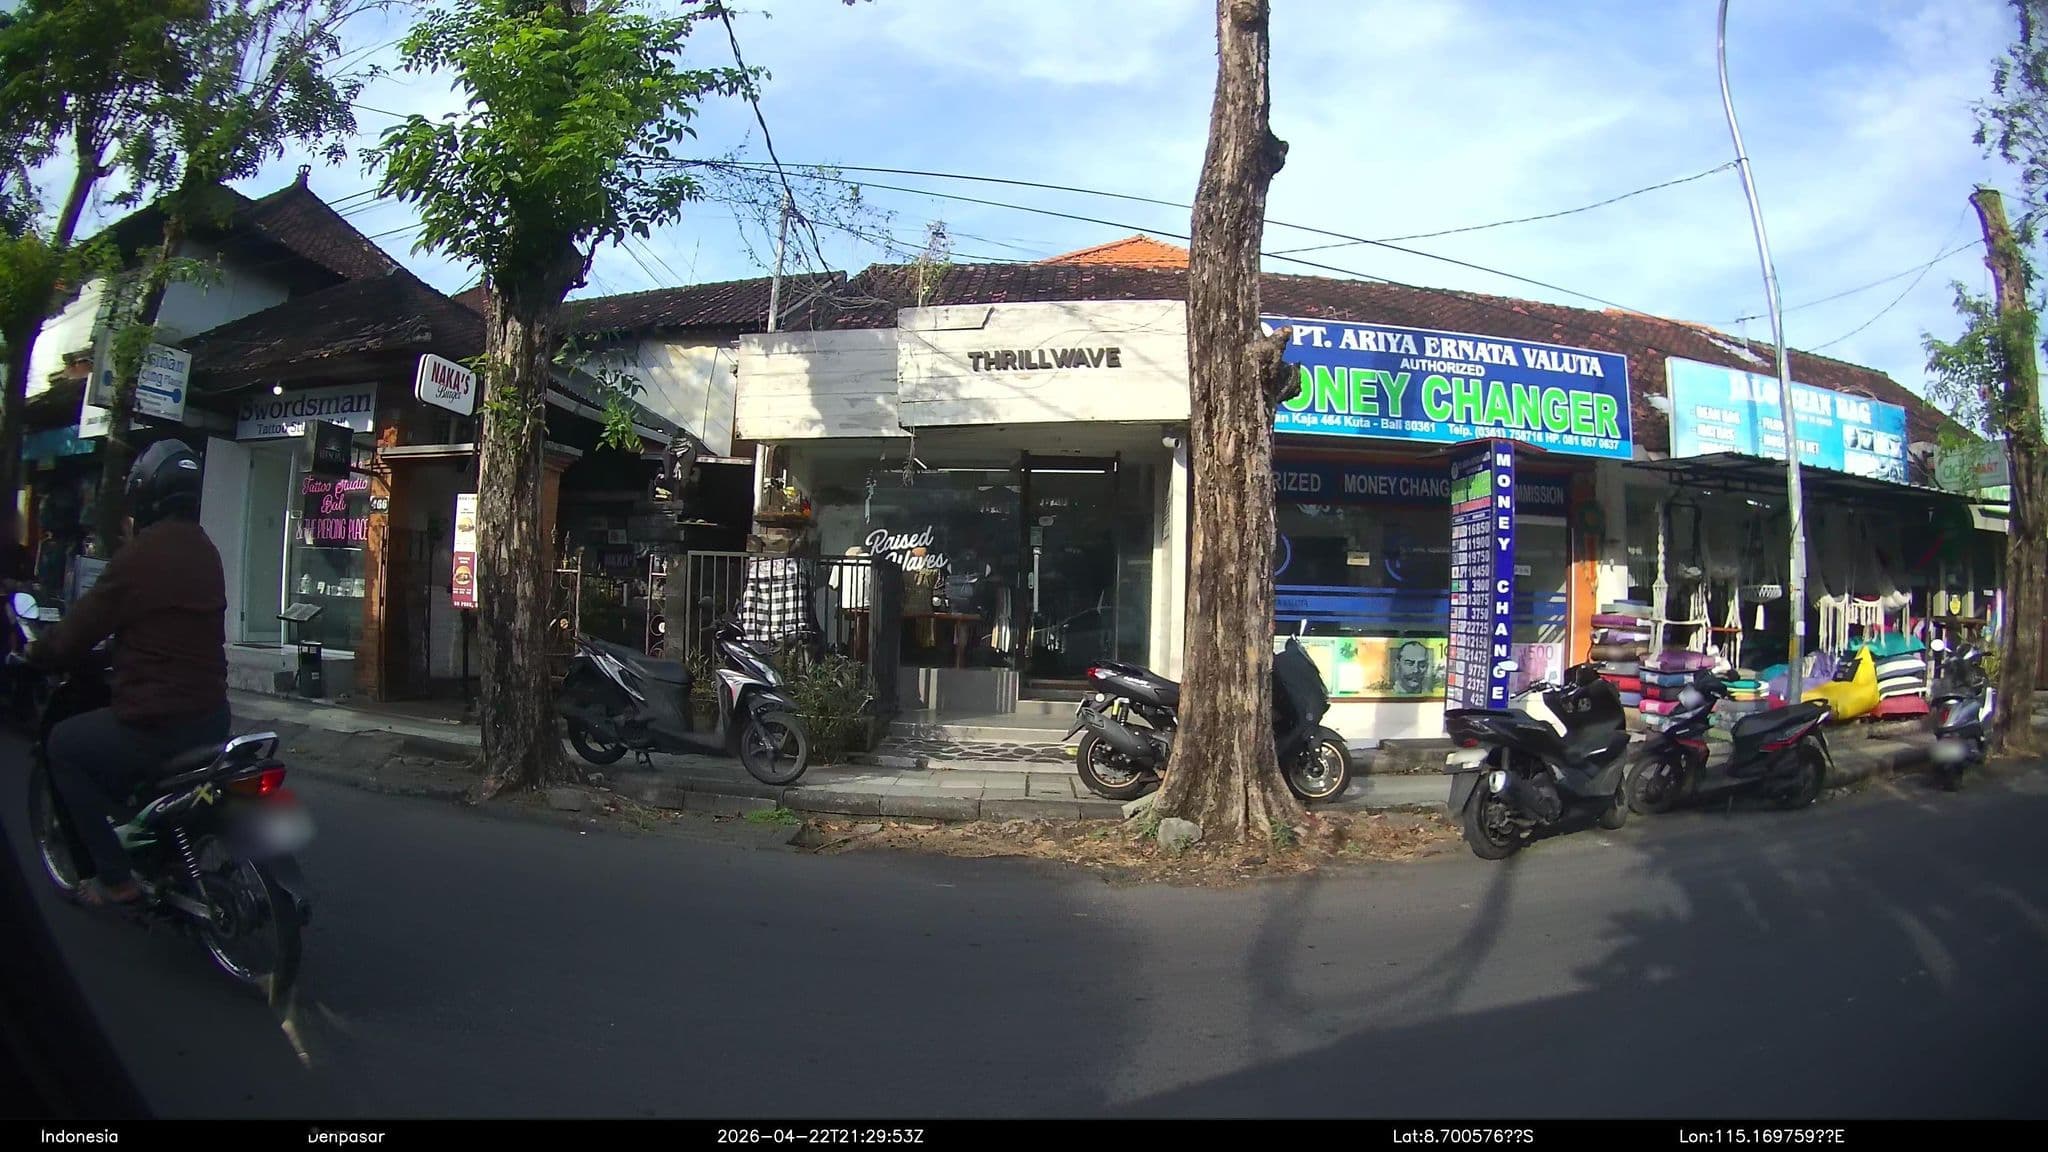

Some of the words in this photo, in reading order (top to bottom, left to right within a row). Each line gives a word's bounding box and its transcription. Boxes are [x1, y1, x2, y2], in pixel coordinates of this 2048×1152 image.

[149, 352, 185, 373] sman
[967, 346, 1122, 372] THRILLWAVE
[1292, 325, 1333, 348] PT.
[1339, 328, 1418, 355] ARIYA
[1423, 337, 1519, 367] ERNATA
[1521, 348, 1605, 378] VALUTA
[431, 361, 471, 396] NAKA'S
[1400, 358, 1486, 378] AUTHORIZED
[240, 392, 372, 421] Swordsman
[1282, 364, 1410, 418] ONEY
[1421, 374, 1623, 440] CHANGER
[257, 422, 287, 436] Tattoo
[1275, 412, 1289, 424] an
[1292, 413, 1318, 427] Kaja
[1343, 415, 1371, 429] Kuta
[1380, 418, 1403, 430] Bali
[302, 475, 331, 495] Tattoo
[334, 477, 368, 500] Studio
[1272, 471, 1321, 493] RIZED
[1344, 473, 1398, 495] MONEY
[1399, 477, 1450, 498] CHANG
[1514, 483, 1564, 505] MMISSION
[321, 494, 347, 514] Bali
[1496, 453, 1512, 551] MONEY
[348, 518, 369, 541] PLACE
[1467, 520, 1491, 535] 16850
[865, 525, 934, 556] Raised
[1467, 549, 1490, 564] 19750
[1491, 579, 1511, 700] CHANGE
[1528, 644, 1554, 661] 500
